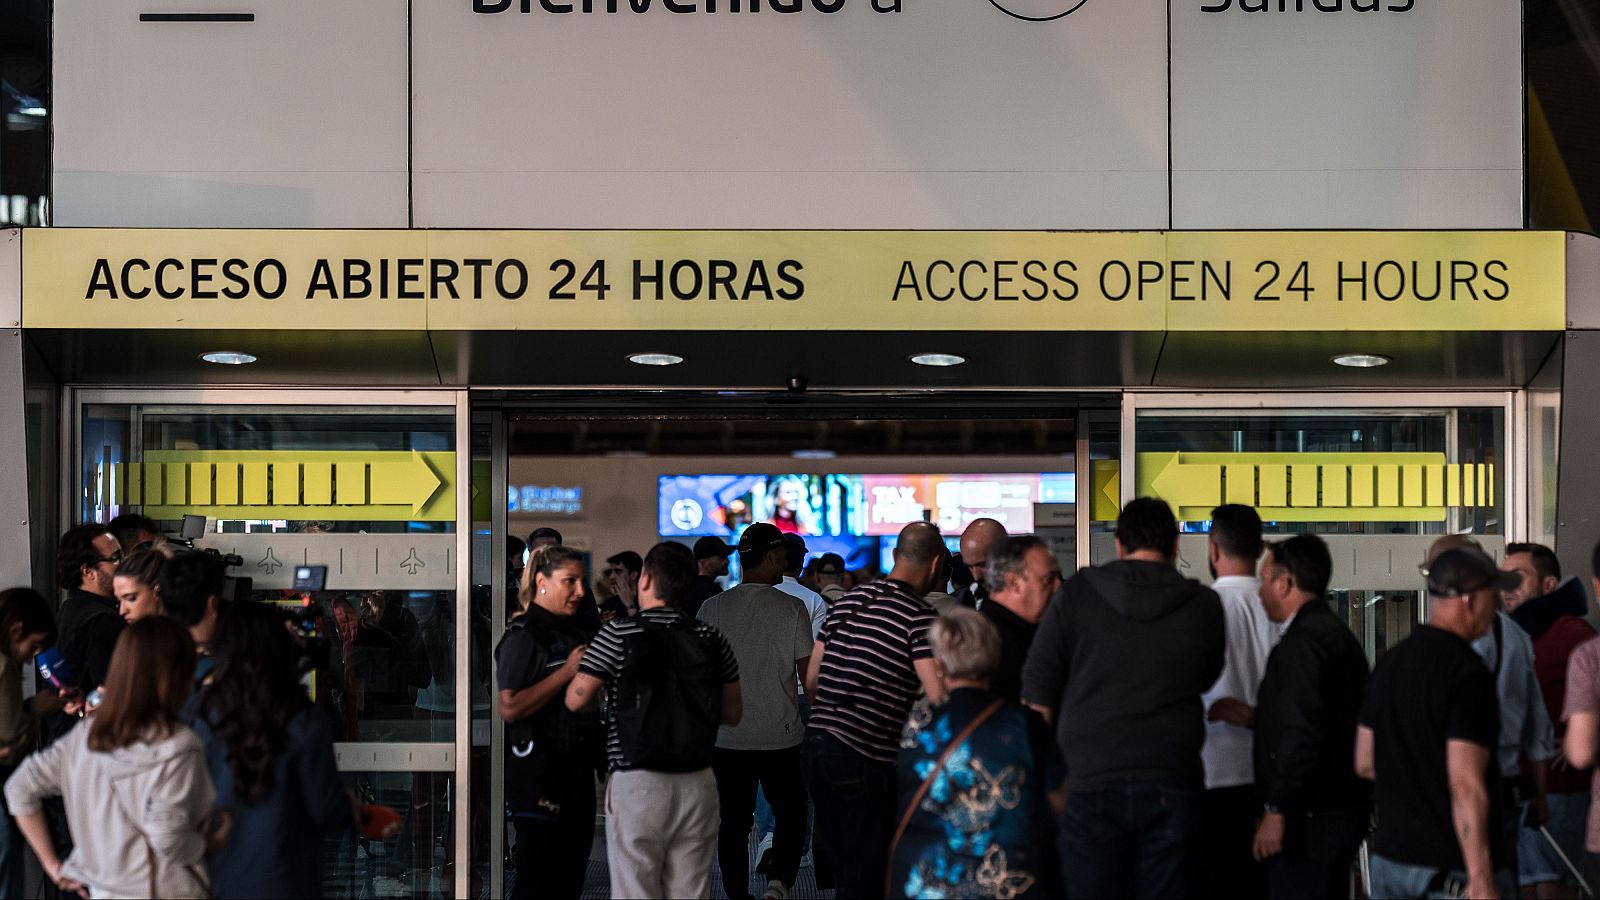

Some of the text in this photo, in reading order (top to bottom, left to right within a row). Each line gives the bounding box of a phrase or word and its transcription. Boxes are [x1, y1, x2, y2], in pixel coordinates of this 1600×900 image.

[85, 258, 805, 302] ACCESO ABIERTO 24 HORAS
[892, 259, 1510, 302] ACCESS OPEN 24 HOURS
